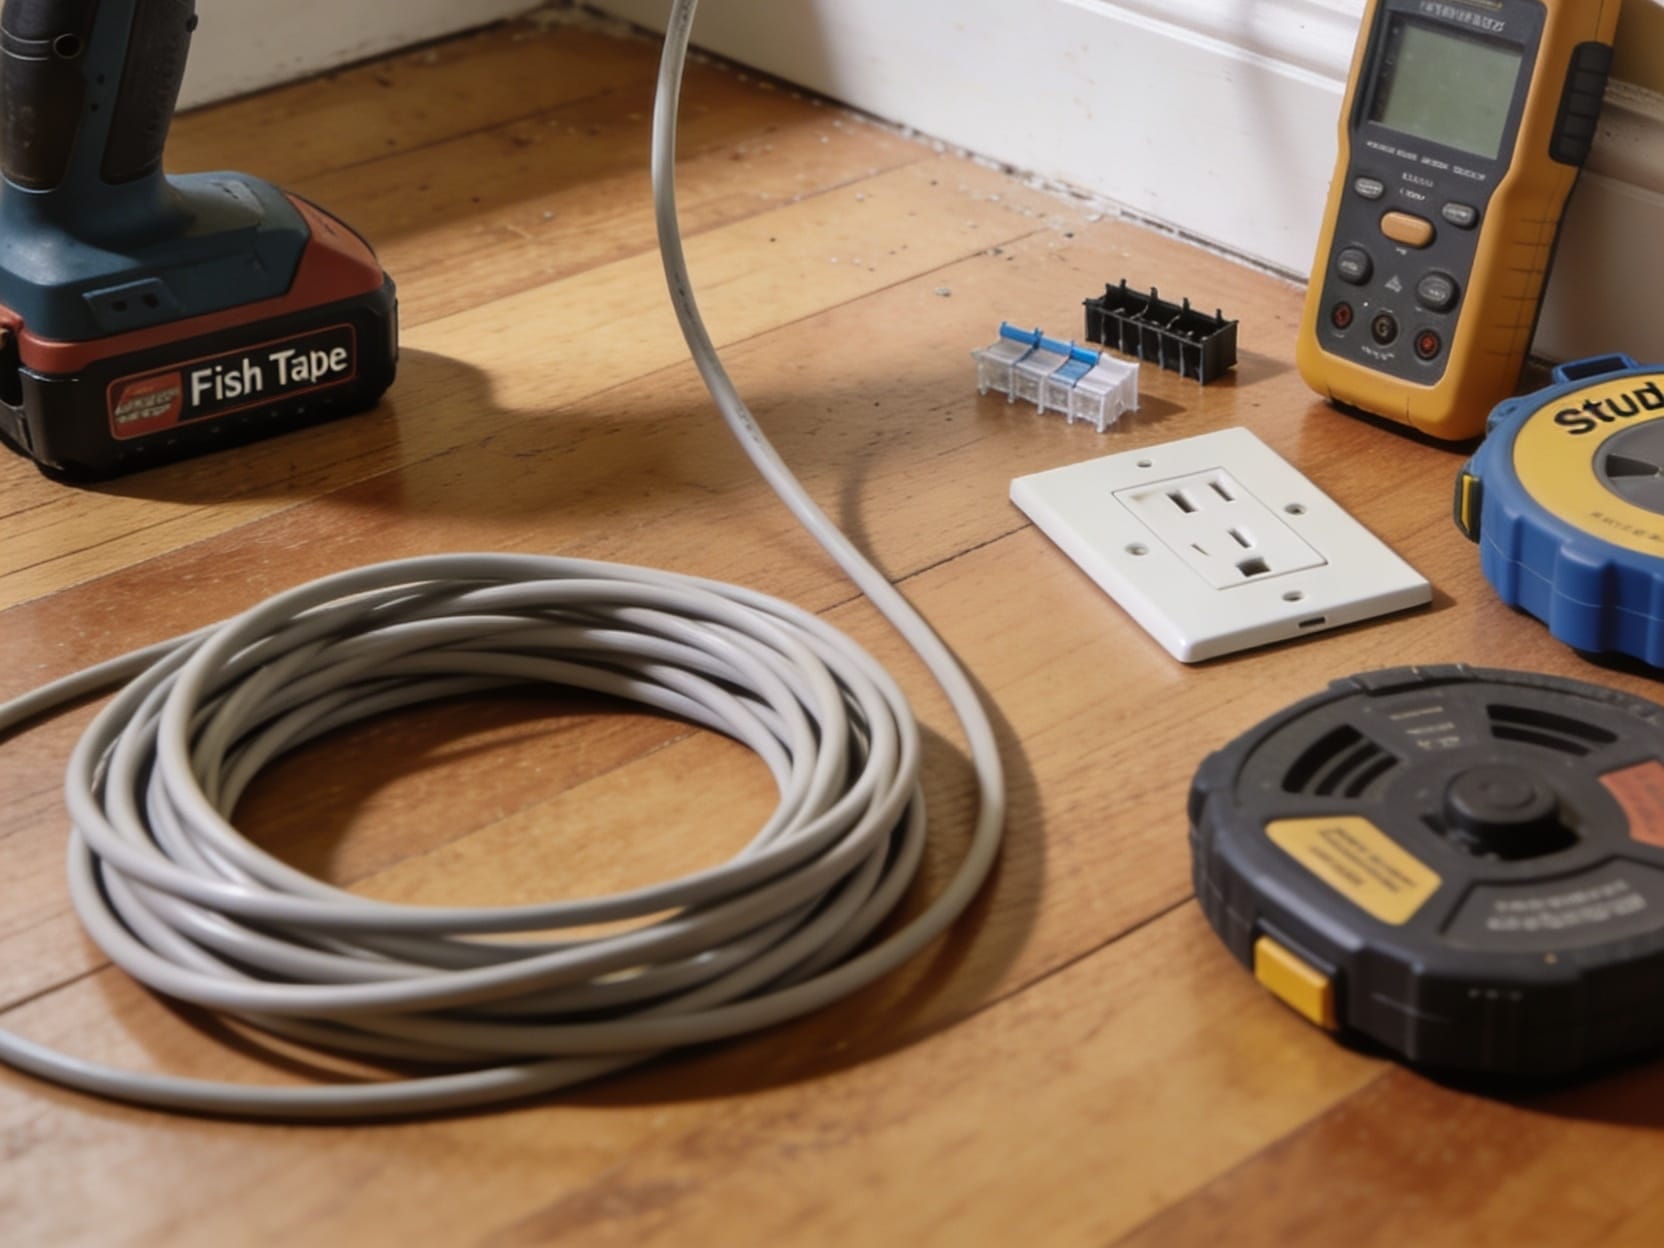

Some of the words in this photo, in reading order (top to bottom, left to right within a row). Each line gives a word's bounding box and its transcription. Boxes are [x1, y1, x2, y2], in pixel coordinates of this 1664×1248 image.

[191, 358, 263, 406] Fish
[269, 347, 348, 386] Tape
[1554, 382, 1664, 435] Stud
